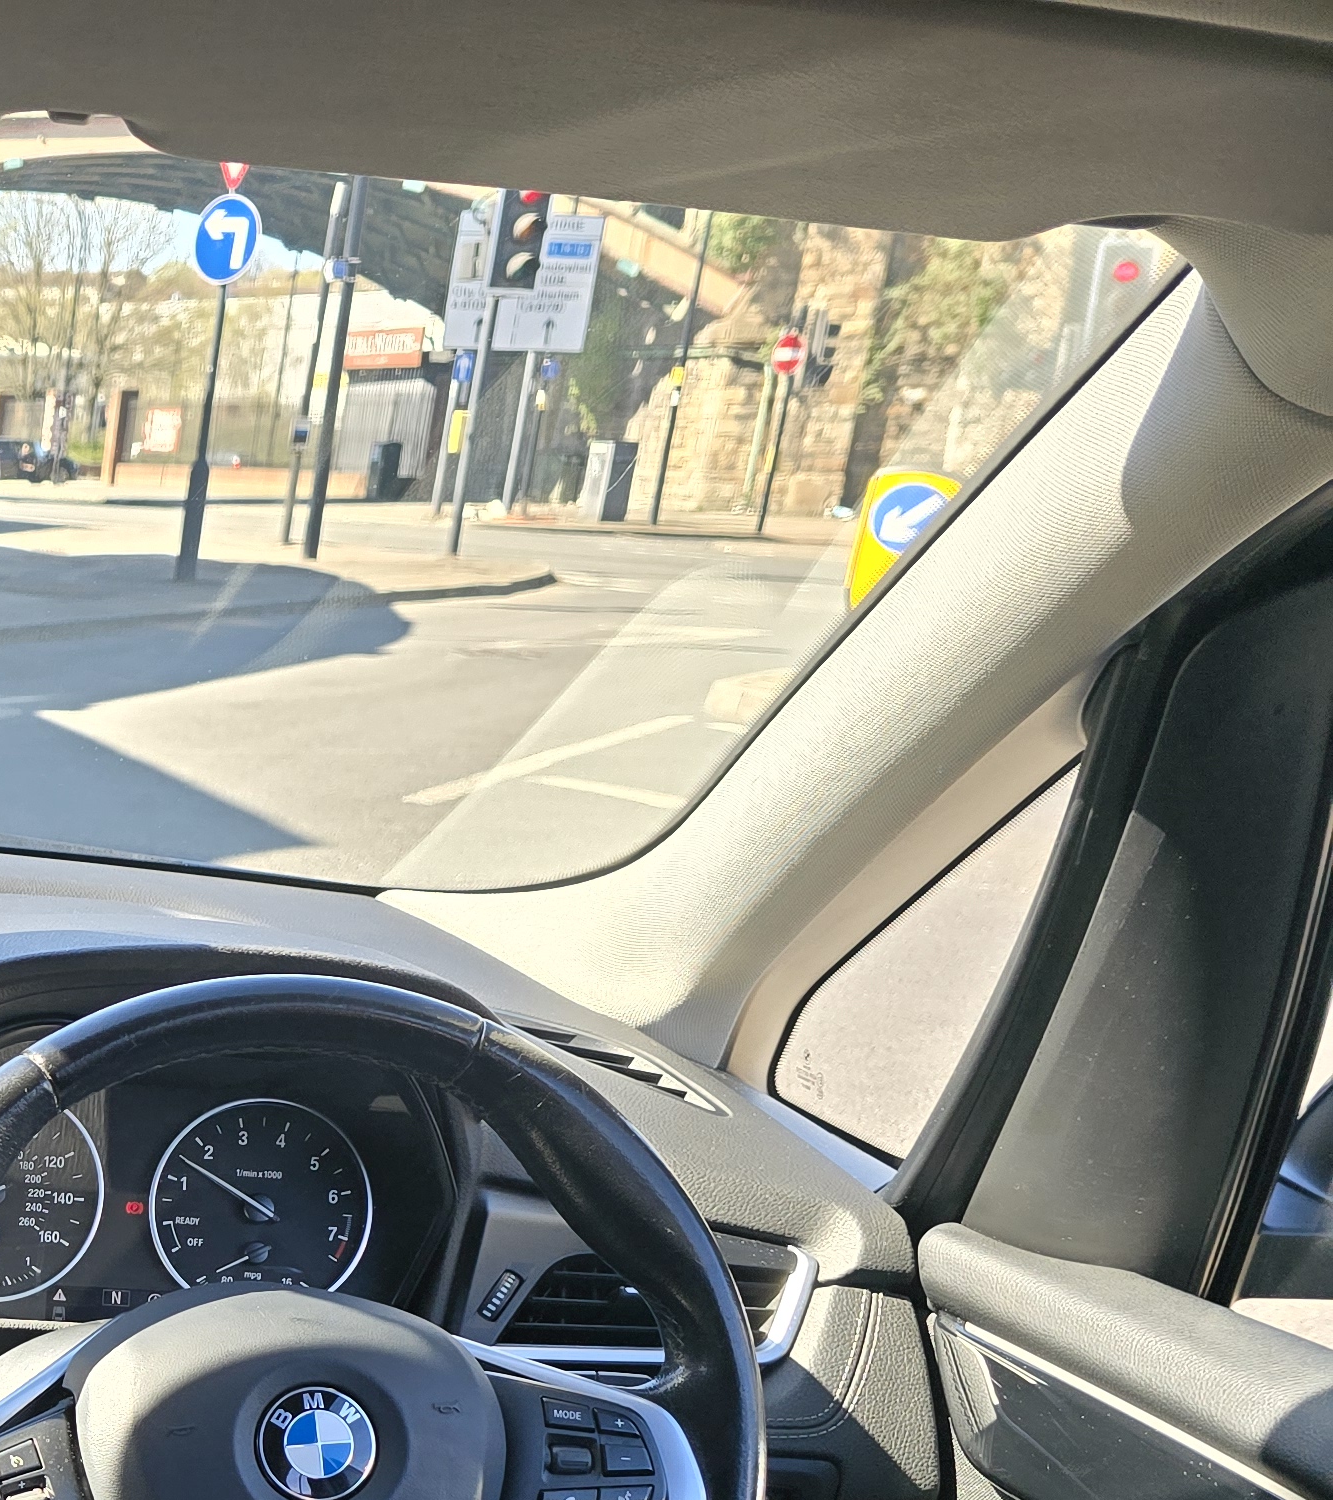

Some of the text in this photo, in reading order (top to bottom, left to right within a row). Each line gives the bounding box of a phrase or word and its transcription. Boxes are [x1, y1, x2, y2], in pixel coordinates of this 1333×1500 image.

[238, 1131, 248, 1146] 3
[276, 1133, 286, 1149] 4
[204, 1145, 214, 1160] 2
[19, 1161, 34, 1171] 180
[44, 1155, 65, 1169] 120
[310, 1156, 320, 1171] 5
[25, 1174, 42, 1184] 200
[264, 1170, 283, 1179] 1000
[180, 1176, 187, 1191] 1
[28, 1189, 45, 1198] 220
[52, 1192, 74, 1205] 140
[328, 1189, 338, 1204] 6
[25, 1203, 43, 1212] 240
[18, 1217, 36, 1227] 260
[175, 1216, 200, 1226] READY
[39, 1231, 60, 1244] 160
[328, 1226, 338, 1242] 7
[187, 1238, 204, 1247] OFF
[25, 1257, 31, 1266] 1
[244, 1271, 262, 1280] mpg
[111, 1291, 122, 1304] N
[270, 1392, 361, 1430] BMW
[553, 1409, 582, 1421] MODE
